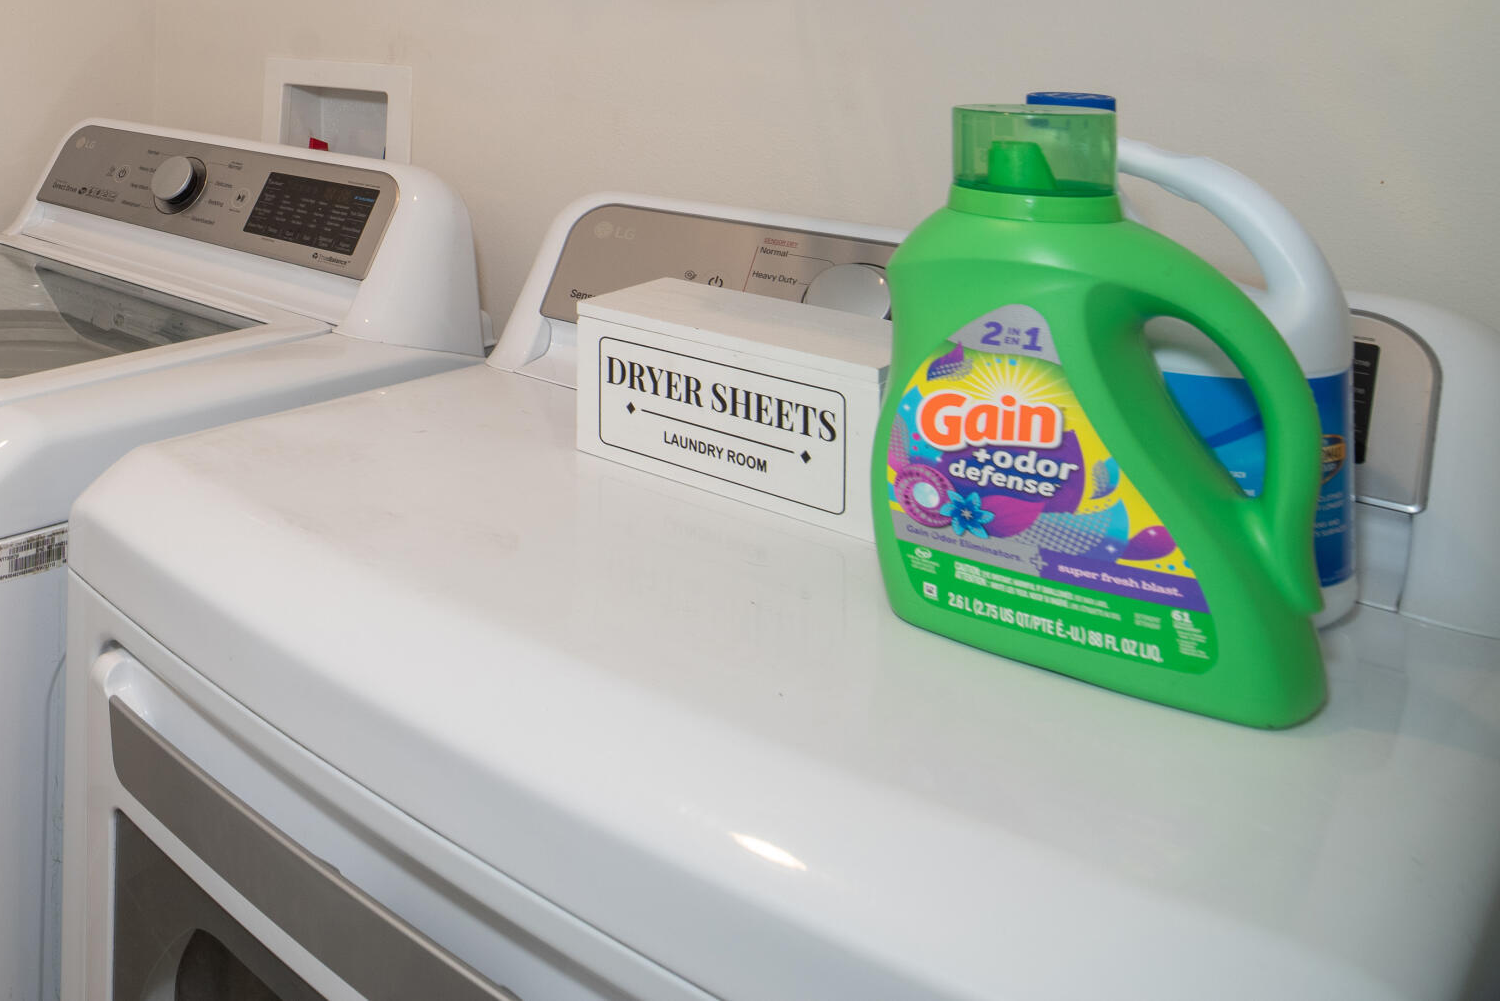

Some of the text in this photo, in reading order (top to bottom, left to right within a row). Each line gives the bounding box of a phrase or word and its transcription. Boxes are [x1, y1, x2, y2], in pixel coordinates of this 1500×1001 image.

[615, 225, 636, 239] LG
[760, 246, 789, 257] Normal
[752, 271, 798, 286] Heavy Duty
[981, 321, 1043, 351] 2 IN 1
[1004, 336, 1019, 345] EN
[606, 355, 837, 442] DRYER SHEETS
[920, 392, 1056, 447] Gain
[663, 430, 768, 473] LAUNDRY ROOM
[906, 523, 930, 538] Gain
[930, 530, 957, 545] Odor
[1057, 564, 1099, 580] super
[1100, 572, 1140, 589] fresh
[965, 596, 973, 612] L
[973, 597, 999, 620] (2.75
[999, 606, 1015, 624] US
[1121, 637, 1138, 657] OZ
[1171, 610, 1192, 623] 61
